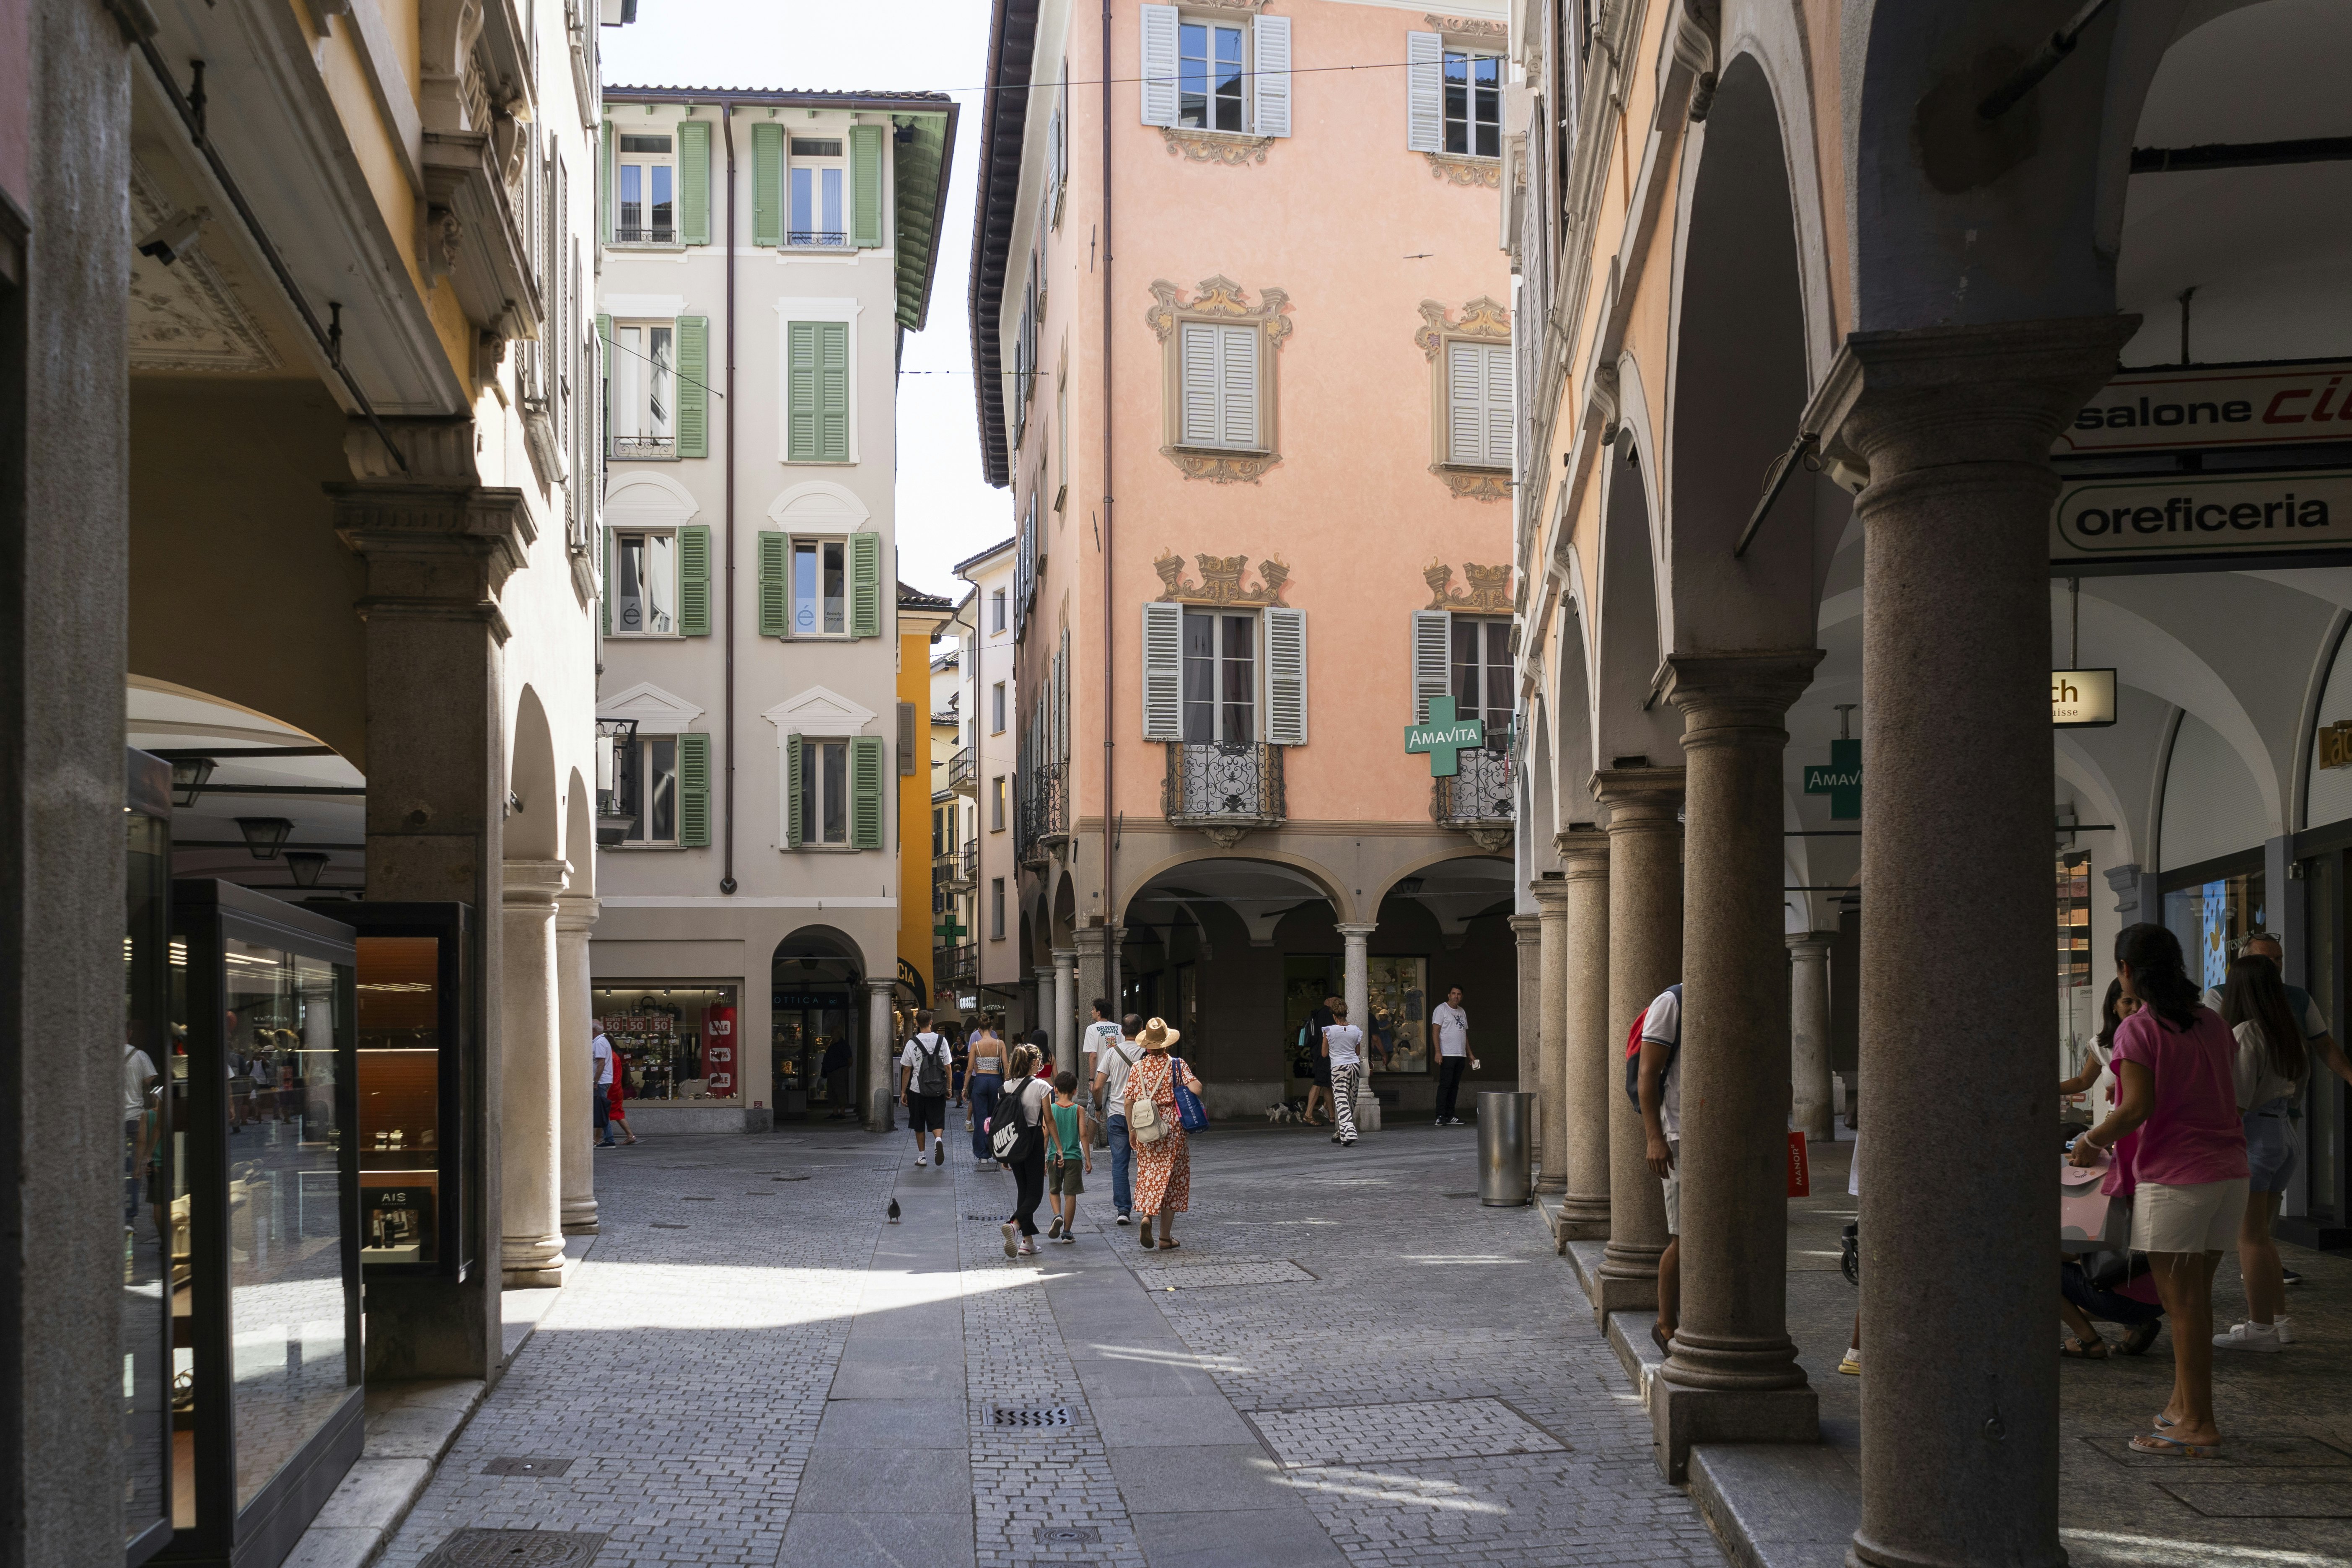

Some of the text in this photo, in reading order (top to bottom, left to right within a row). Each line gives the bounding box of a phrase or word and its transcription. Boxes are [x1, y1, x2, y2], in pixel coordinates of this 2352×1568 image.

[2075, 397, 2252, 430] salone
[2076, 494, 2329, 536] oreficeria
[1409, 726, 1478, 748] AMAVITA
[606, 1021, 620, 1030] 50
[630, 1021, 644, 1030] 50
[654, 1021, 668, 1030] 50
[993, 1122, 1018, 1150] NIKE
[1792, 1148, 1803, 1186] MANOR
